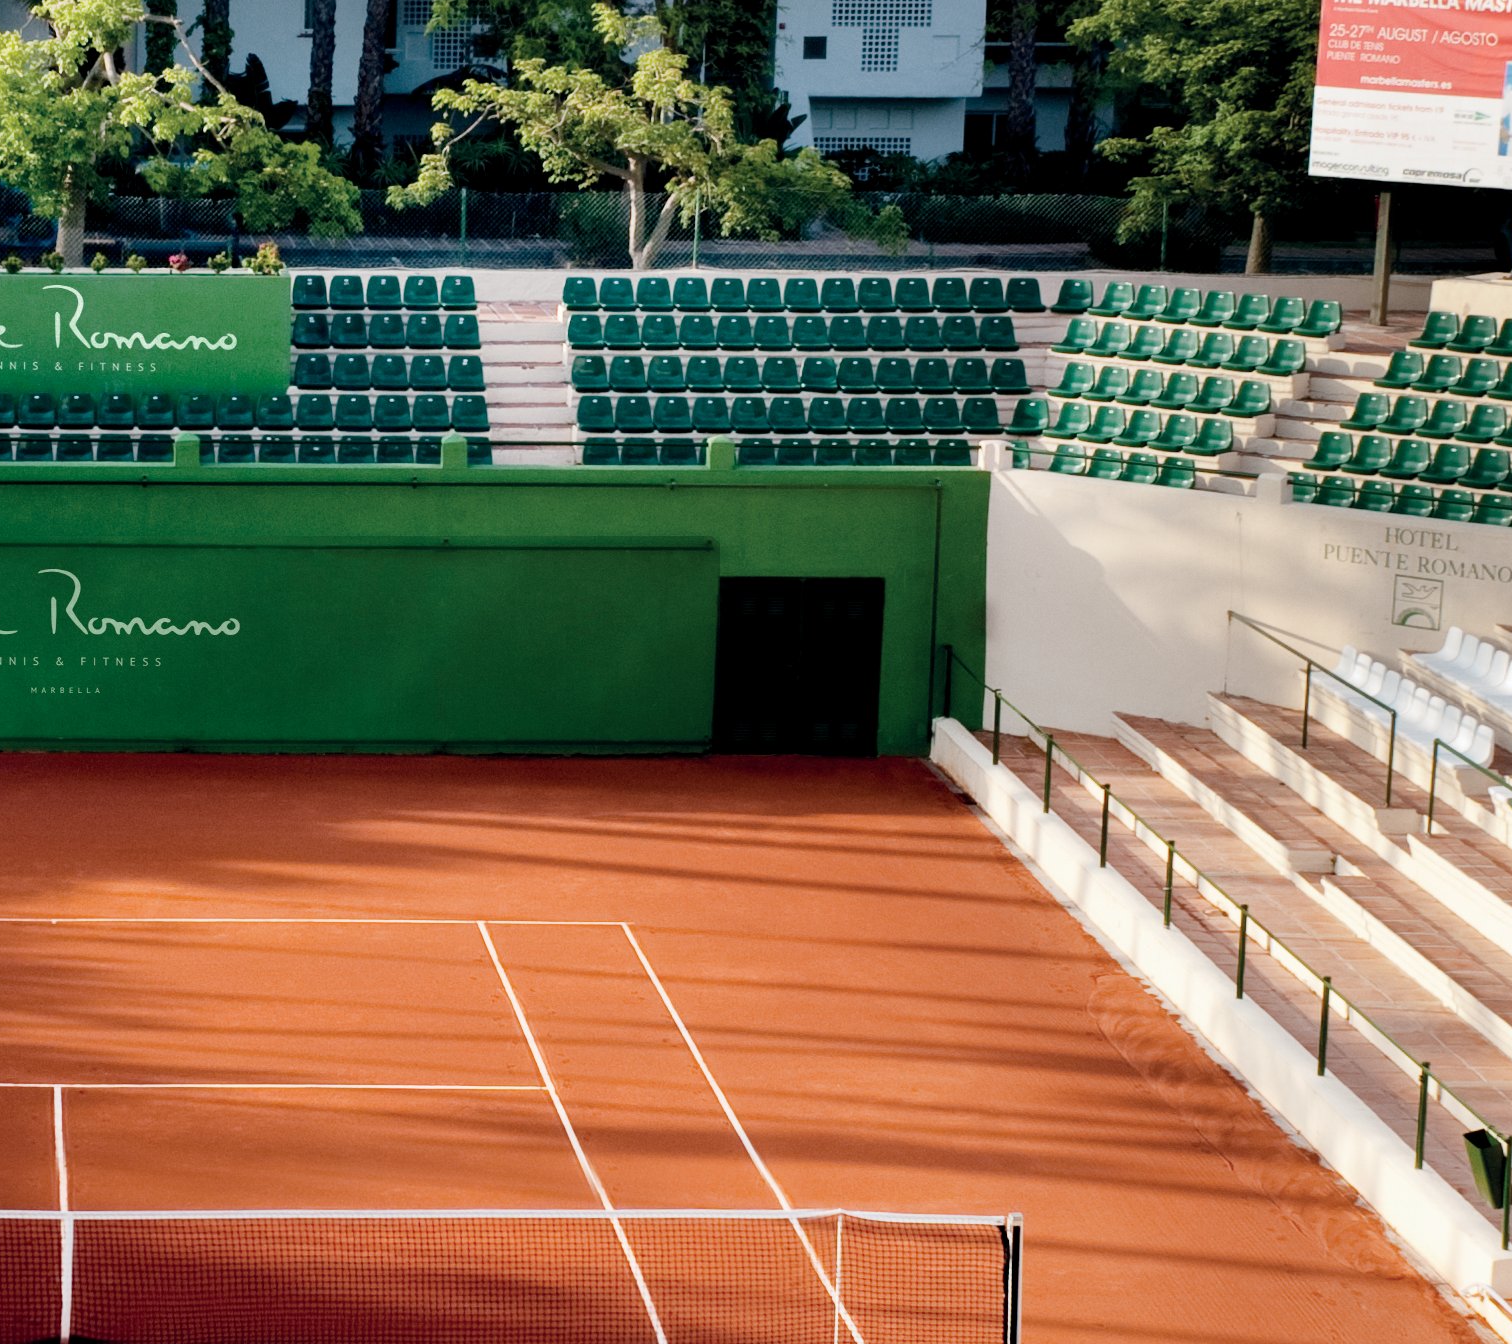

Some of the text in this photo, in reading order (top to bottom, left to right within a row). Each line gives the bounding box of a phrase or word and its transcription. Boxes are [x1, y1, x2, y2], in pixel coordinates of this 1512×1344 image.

[1377, 27, 1428, 42] AUGUST
[1439, 31, 1499, 47] AGOSTO
[1327, 39, 1349, 50] CLUB
[1350, 40, 1361, 51] DE
[1326, 51, 1401, 64] PUENTE ROMANO
[1360, 75, 1453, 90] marbellamasters.es
[42, 284, 238, 352] Romano
[54, 361, 64, 372] &
[78, 362, 158, 373] FITNESS
[1384, 527, 1460, 553] HOTEL
[1323, 543, 1409, 572] PUENTE
[37, 567, 242, 637] Romano
[55, 656, 65, 667] &
[80, 656, 164, 668] FITNESS
[30, 686, 102, 695] MARBELLA
